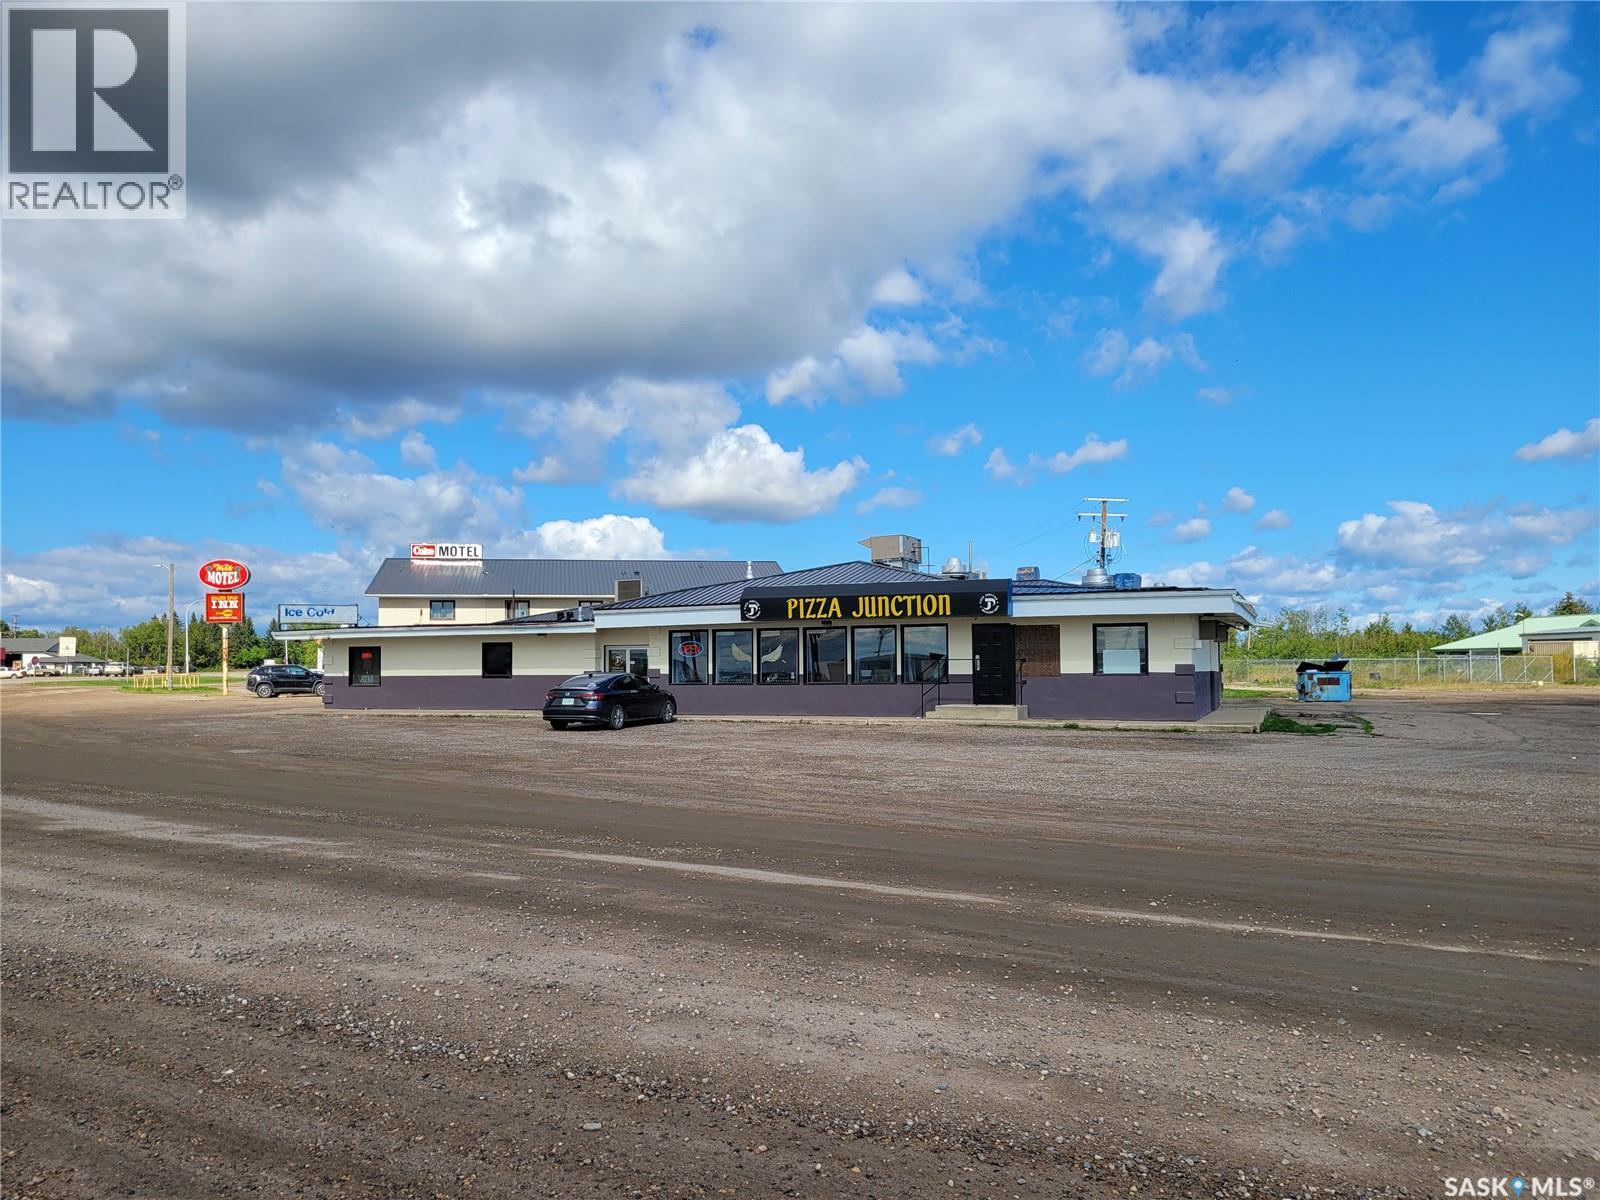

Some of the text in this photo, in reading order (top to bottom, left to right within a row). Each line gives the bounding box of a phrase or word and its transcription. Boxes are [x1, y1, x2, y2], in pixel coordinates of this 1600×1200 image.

[438, 545, 479, 558] MOTEL
[207, 571, 240, 585] MOTEL
[210, 600, 239, 609] INN
[786, 597, 842, 619] PIZZA
[852, 594, 952, 618] JUNCTION
[284, 607, 303, 617] Ice
